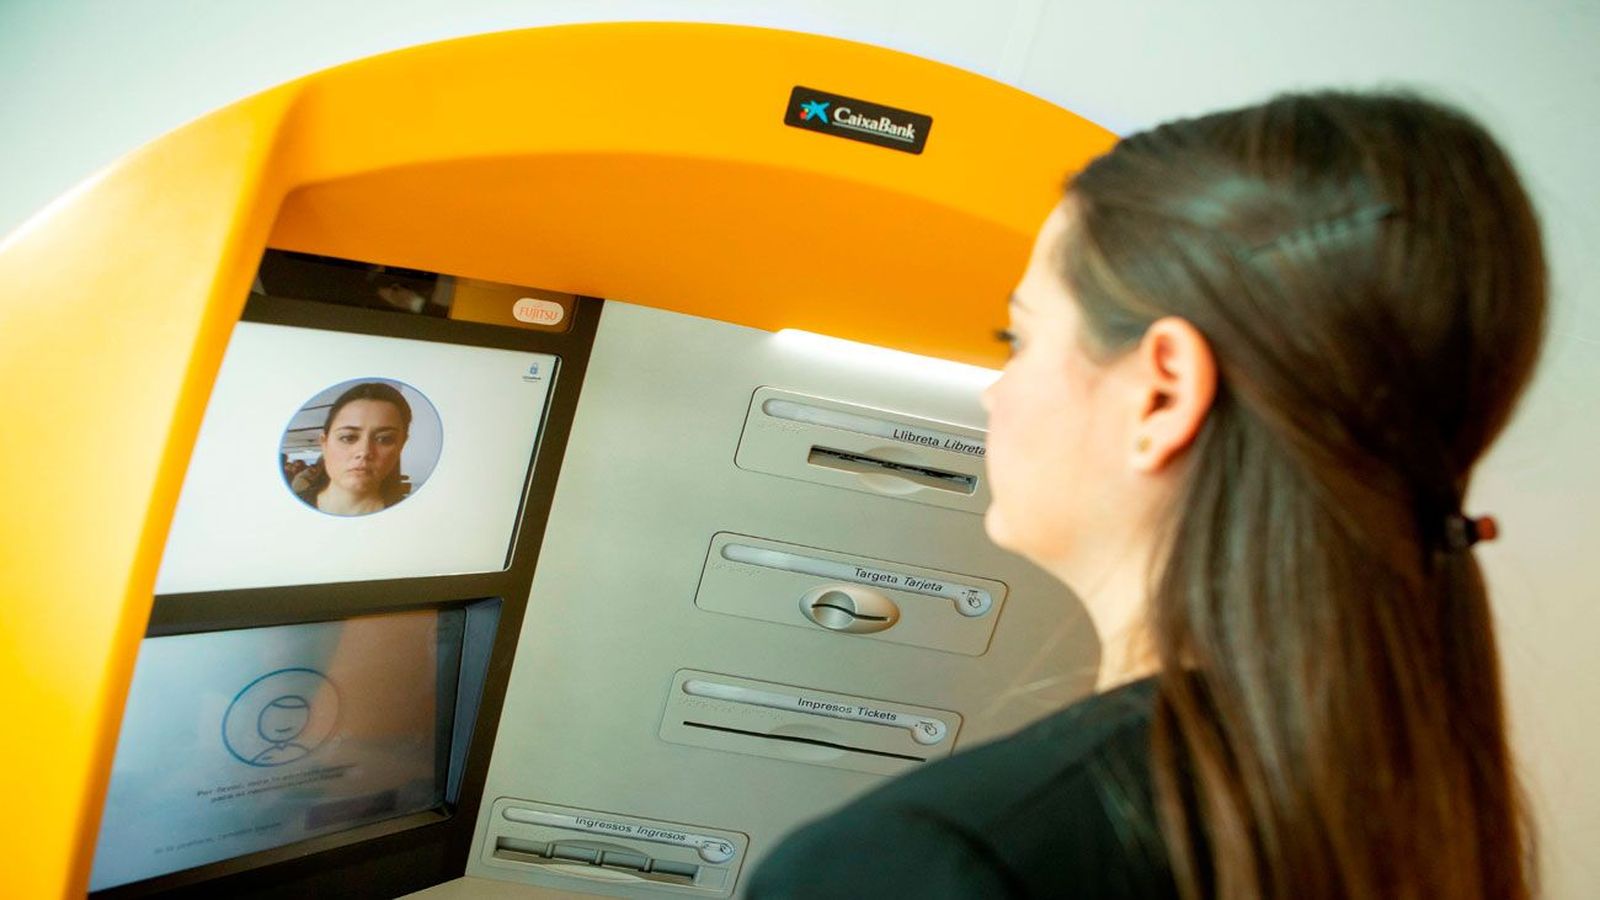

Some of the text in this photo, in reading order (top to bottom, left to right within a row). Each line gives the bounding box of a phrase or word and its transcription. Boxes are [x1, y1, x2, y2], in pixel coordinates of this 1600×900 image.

[833, 107, 915, 139] CaixaBank
[519, 306, 559, 320] FUJITSU
[893, 428, 986, 455] Llibreta Libreta
[854, 567, 944, 592] Targeta Tarjeta
[798, 697, 897, 721] Impresos Tickets
[575, 816, 687, 842] Ingressos Ingresos
